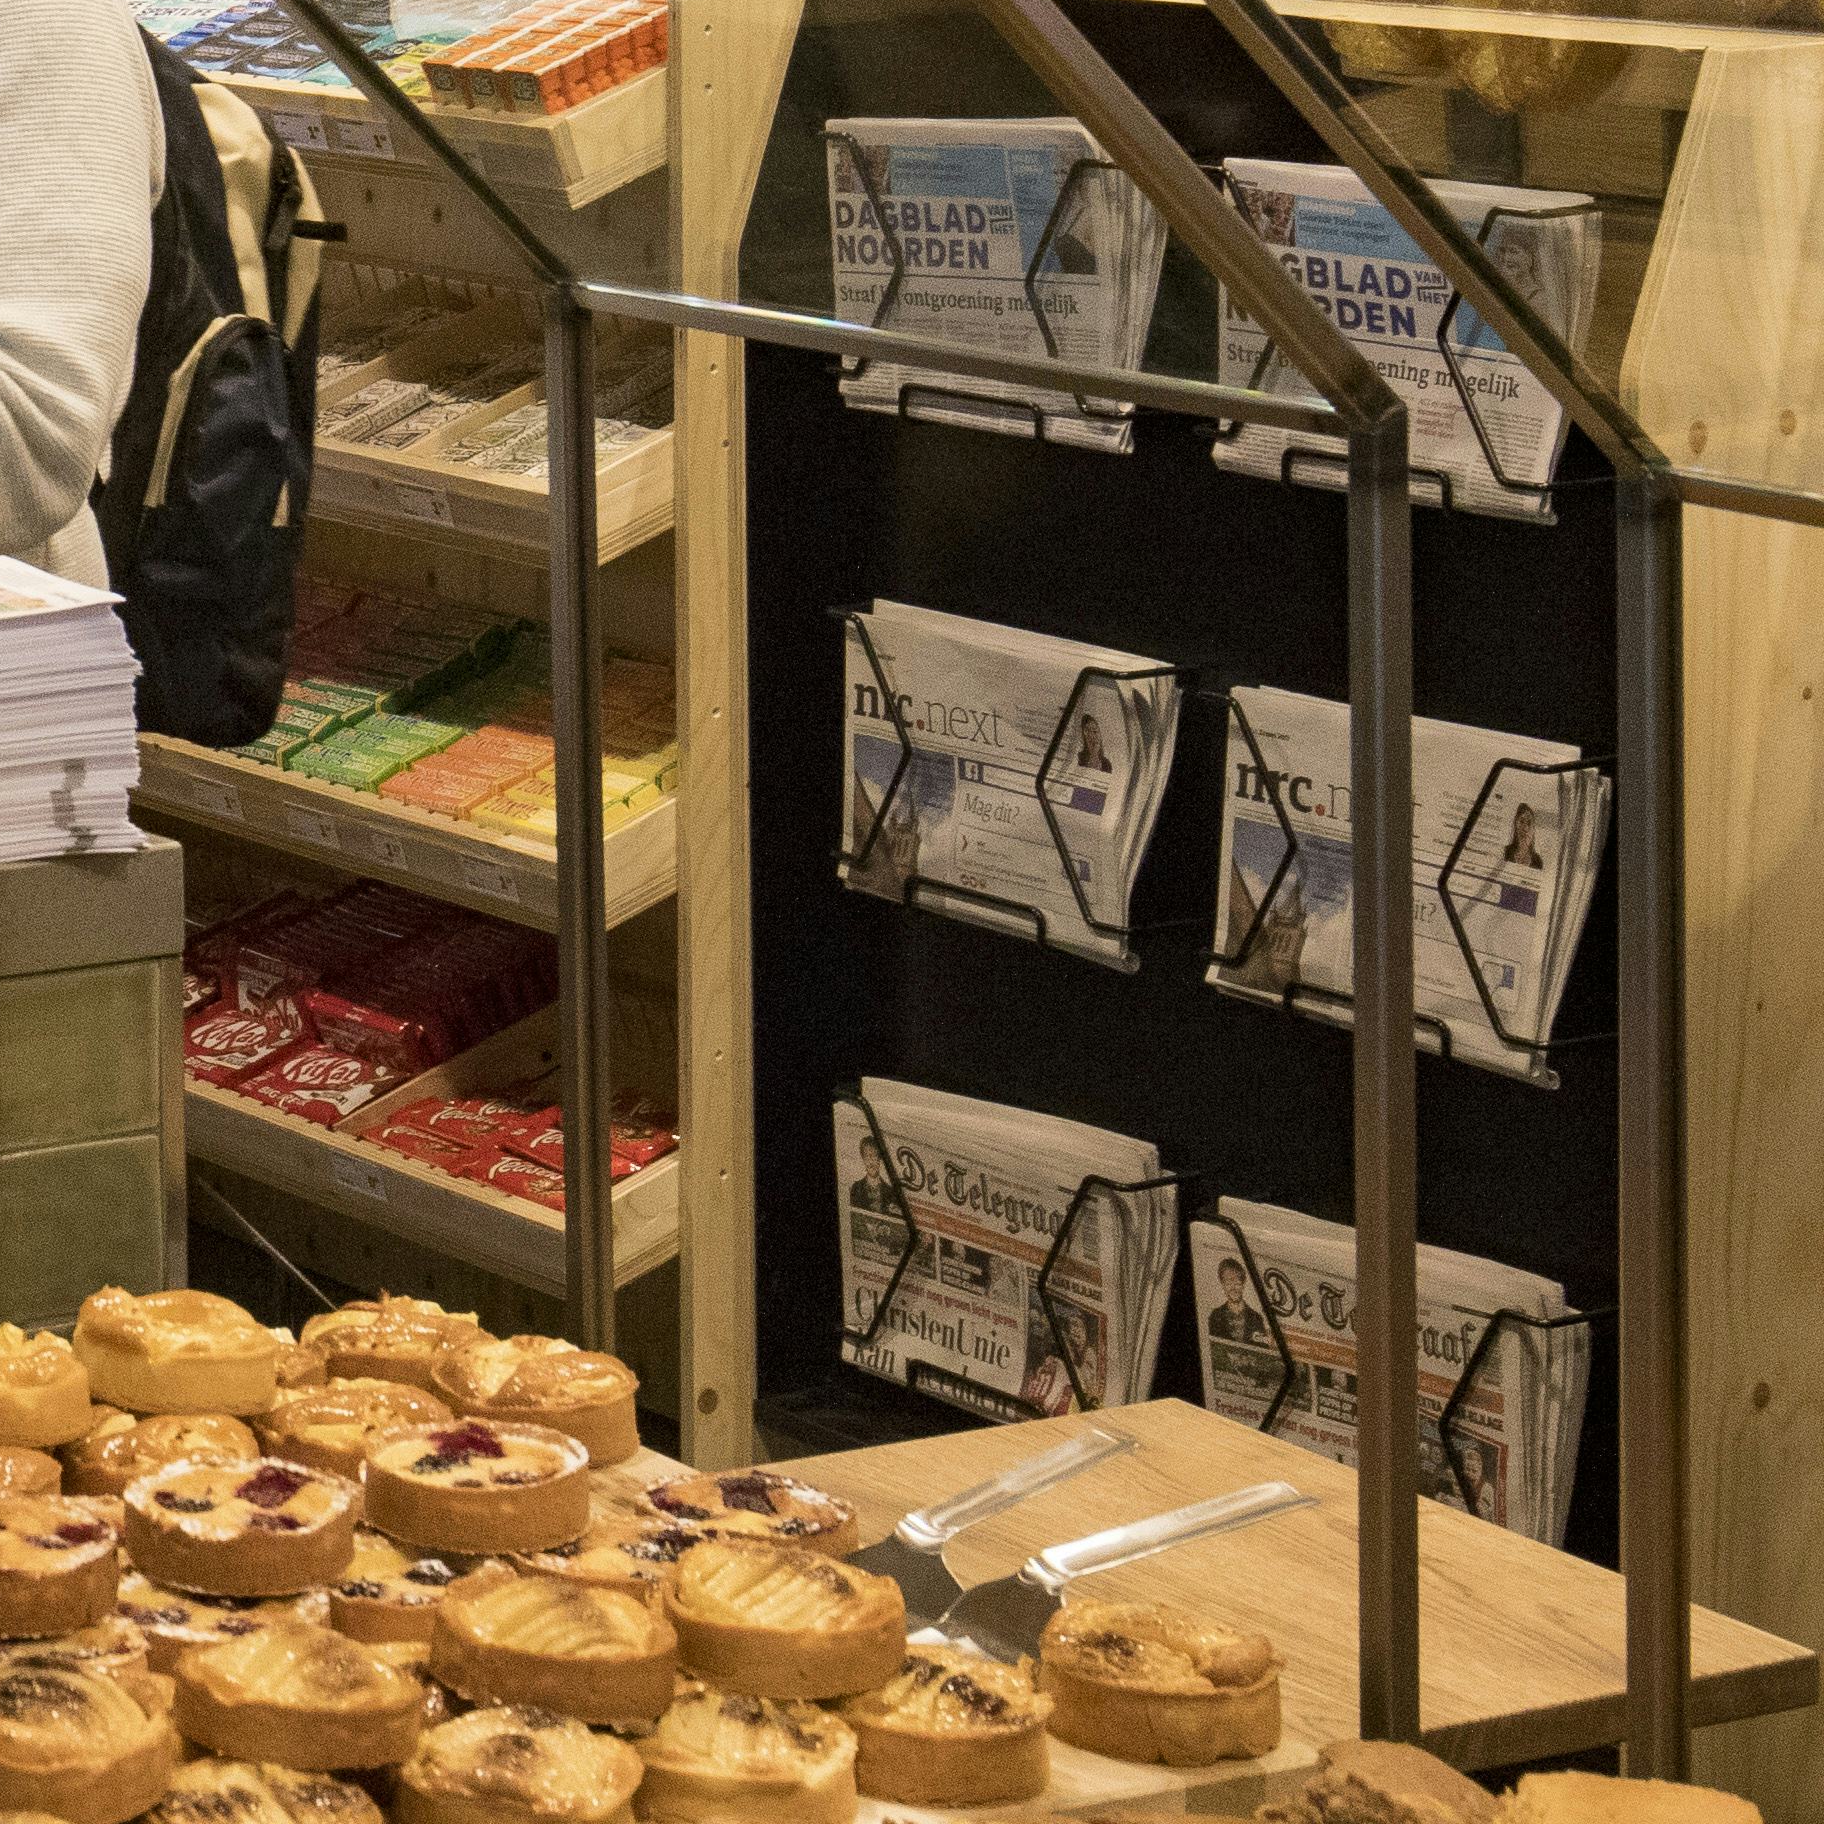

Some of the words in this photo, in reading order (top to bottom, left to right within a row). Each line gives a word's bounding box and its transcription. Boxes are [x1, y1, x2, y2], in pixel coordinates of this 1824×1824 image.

[835, 199, 987, 234] DAGBLAD
[837, 234, 991, 270] NOORDEN
[1279, 252, 1413, 300] GBLAD
[902, 290, 1004, 316] ontgroening
[1434, 367, 1521, 402] mgelijk
[943, 1160, 1067, 1239] Telegraa
